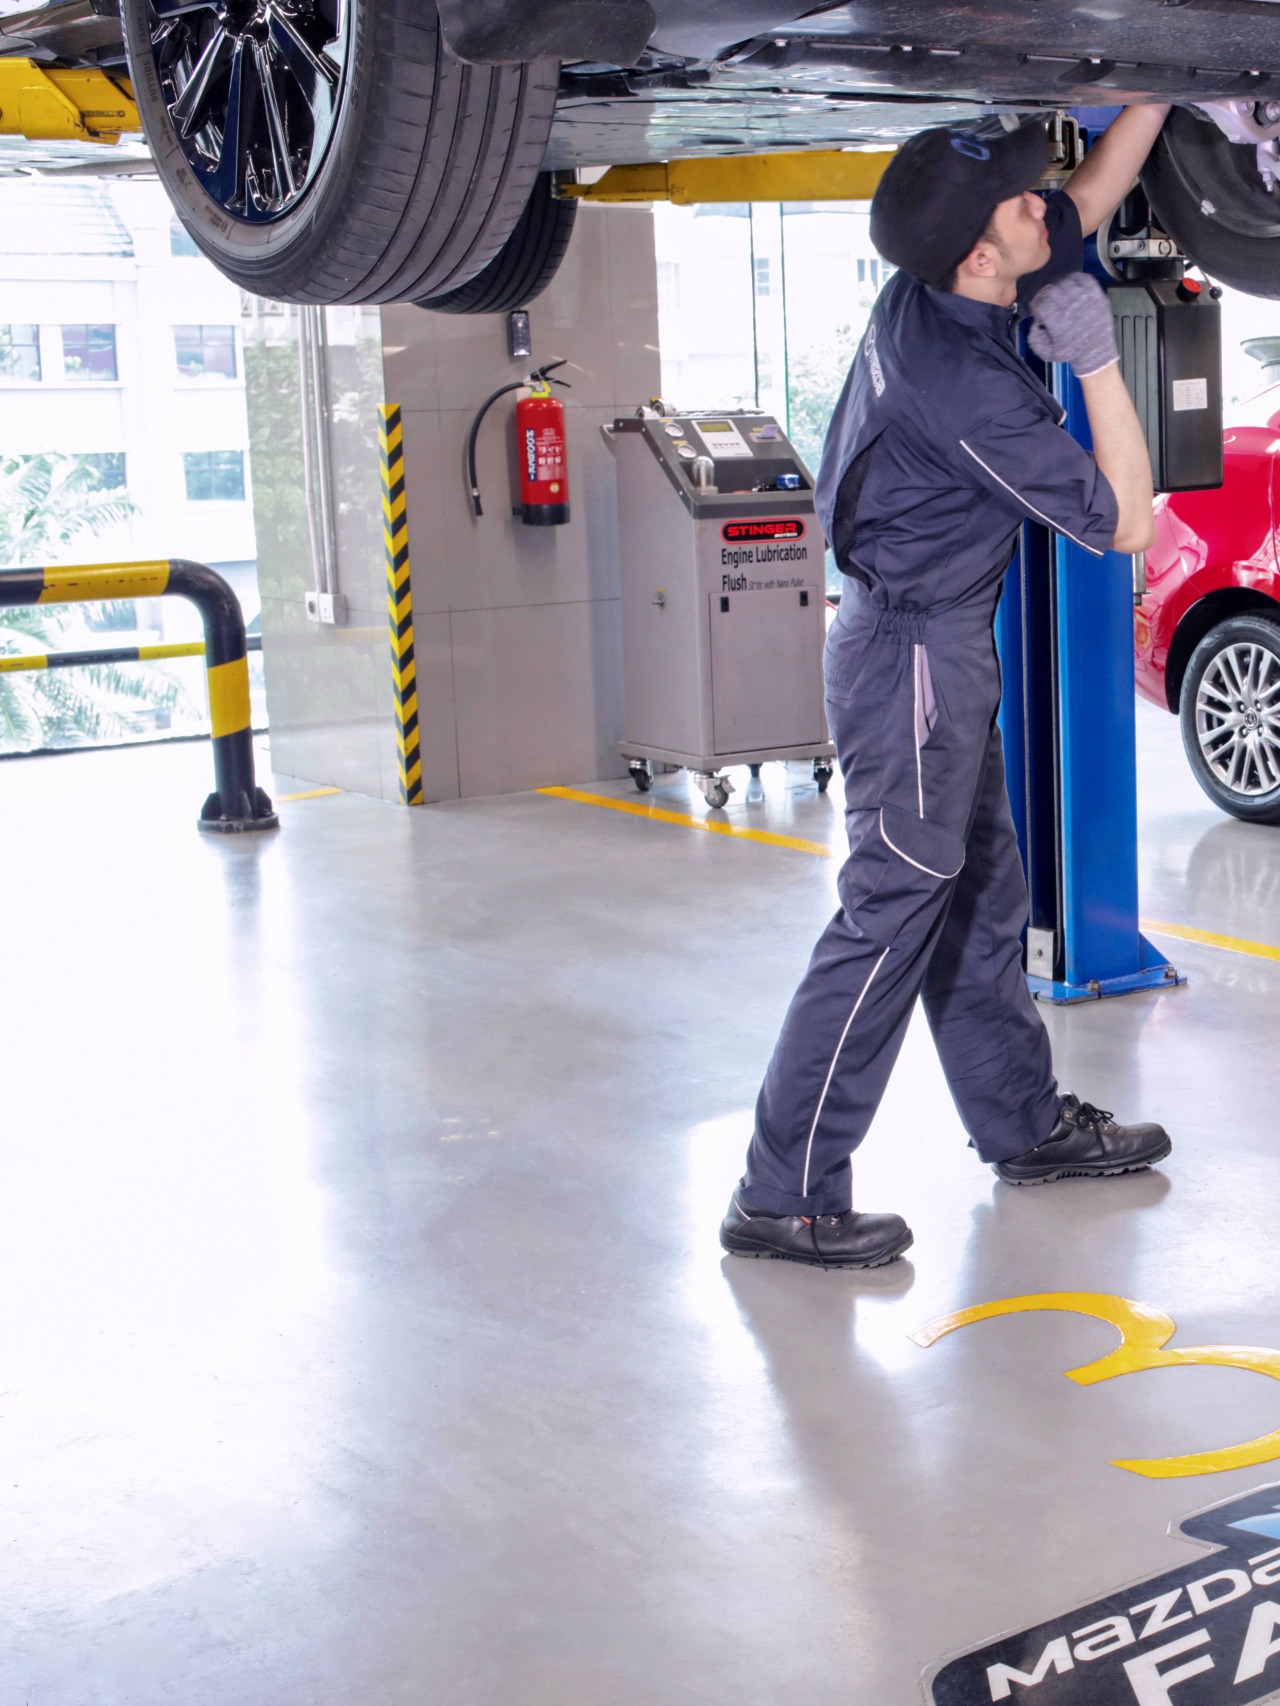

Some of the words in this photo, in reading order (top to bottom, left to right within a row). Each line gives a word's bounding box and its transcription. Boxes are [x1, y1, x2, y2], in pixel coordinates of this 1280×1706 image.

[727, 522, 797, 537] STINGER
[721, 546, 753, 568] Engine
[756, 543, 807, 563] Lubrication
[722, 573, 747, 591] Flush
